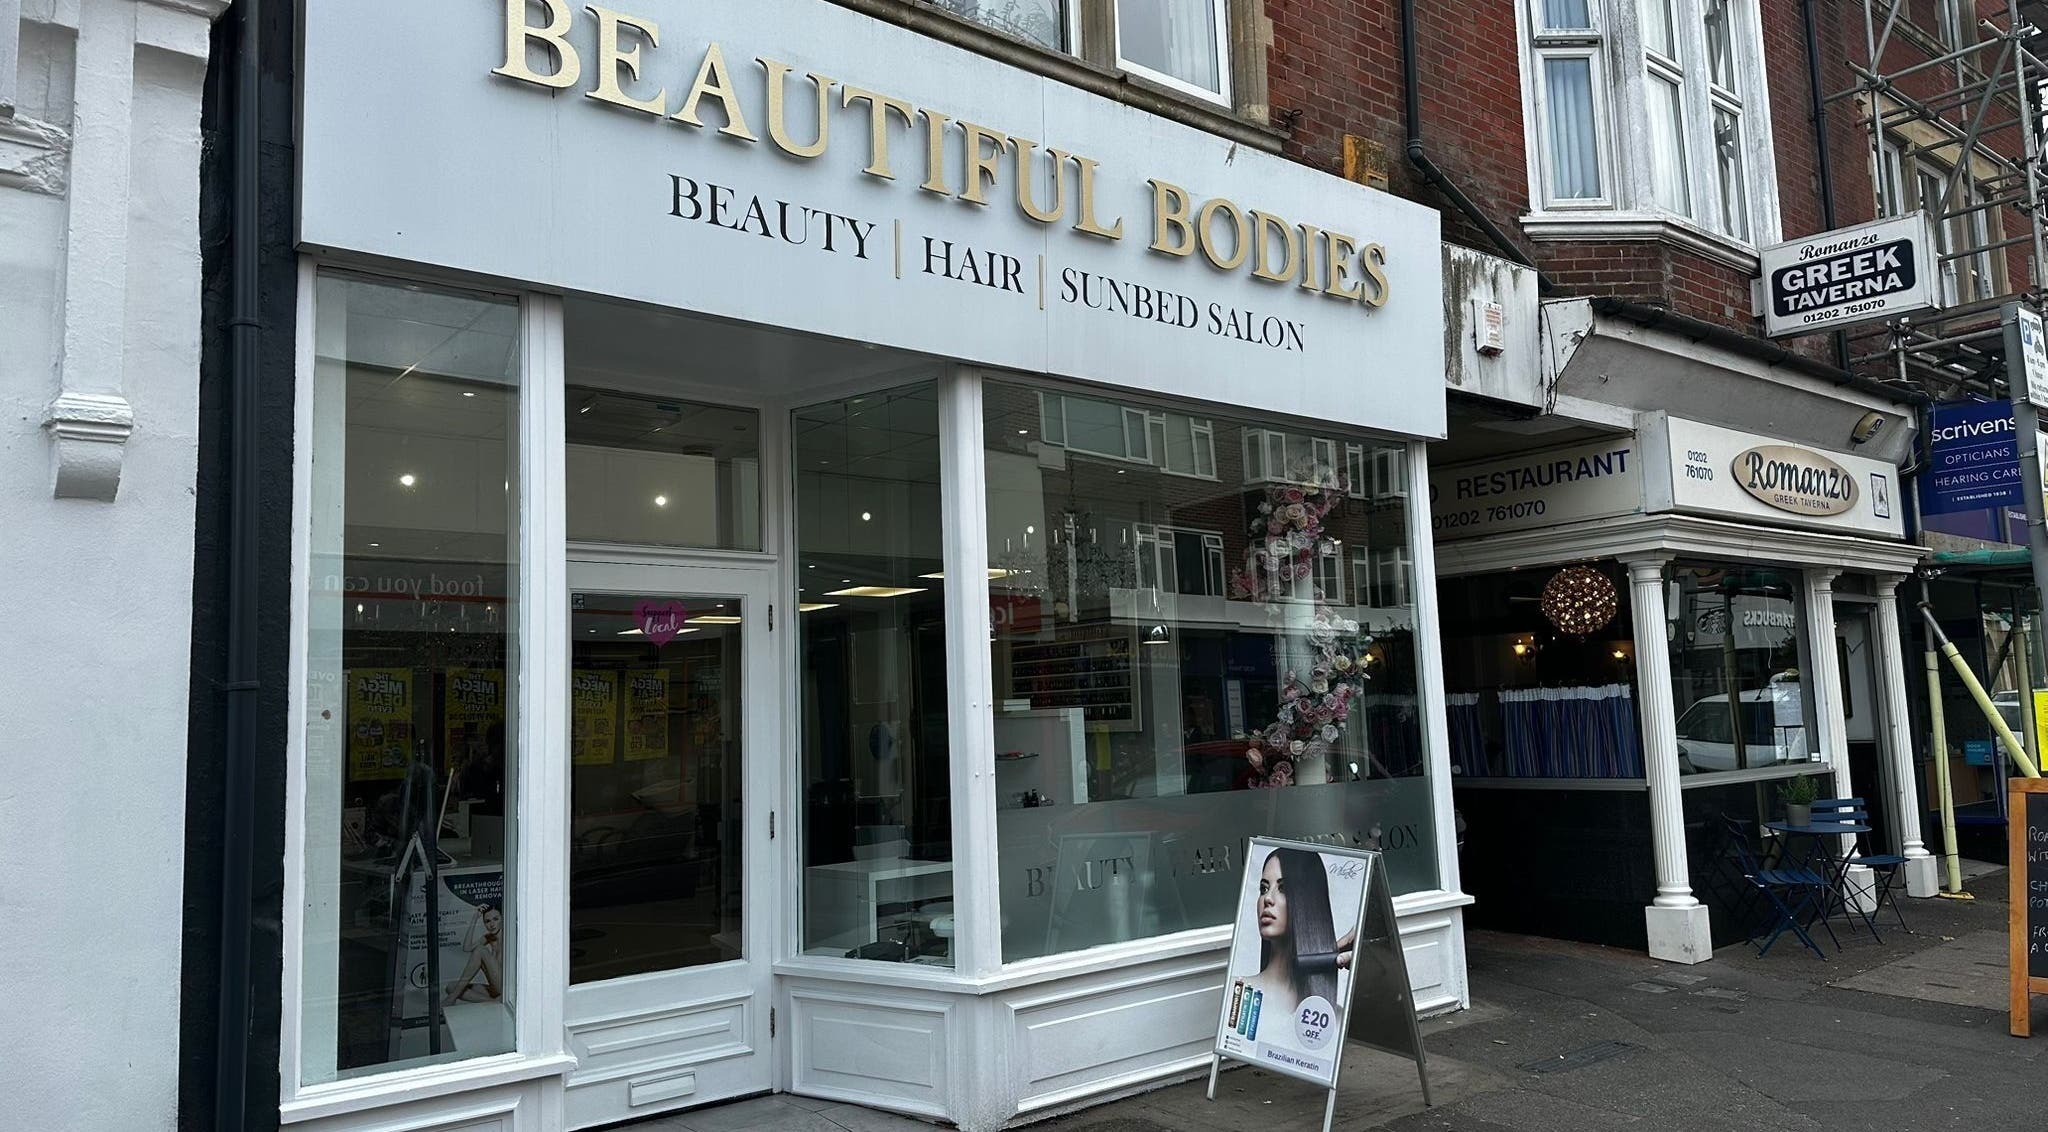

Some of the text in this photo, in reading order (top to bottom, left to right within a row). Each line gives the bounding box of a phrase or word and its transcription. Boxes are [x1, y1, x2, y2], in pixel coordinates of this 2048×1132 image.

[490, 0, 1390, 308] BEAUTIFUL BODIES
[667, 173, 876, 260] BEAUTY
[1799, 233, 1880, 261] Romanzo
[922, 236, 1025, 294] HAIR
[1781, 245, 1902, 292] GREEK
[1783, 272, 1904, 312] TAVERNA
[1061, 267, 1305, 353] SUNBED SALON
[1803, 299, 1886, 324] 01202 761070
[1931, 417, 2016, 443] scrivens
[1687, 450, 1708, 464] 01202
[1945, 447, 2010, 465] OPTICIANS
[1456, 449, 1631, 500] RESTAURANT
[1685, 464, 1714, 482] 761070
[1745, 451, 1851, 502] Romanzo
[1935, 471, 1989, 487] HEARING
[1432, 500, 1546, 530] 01202 761070
[1774, 494, 1831, 511] GREEK TAVERNA
[645, 613, 679, 634] Local
[1301, 1008, 1330, 1029] £20
[1267, 1049, 1320, 1072] Brazilian Keratin
